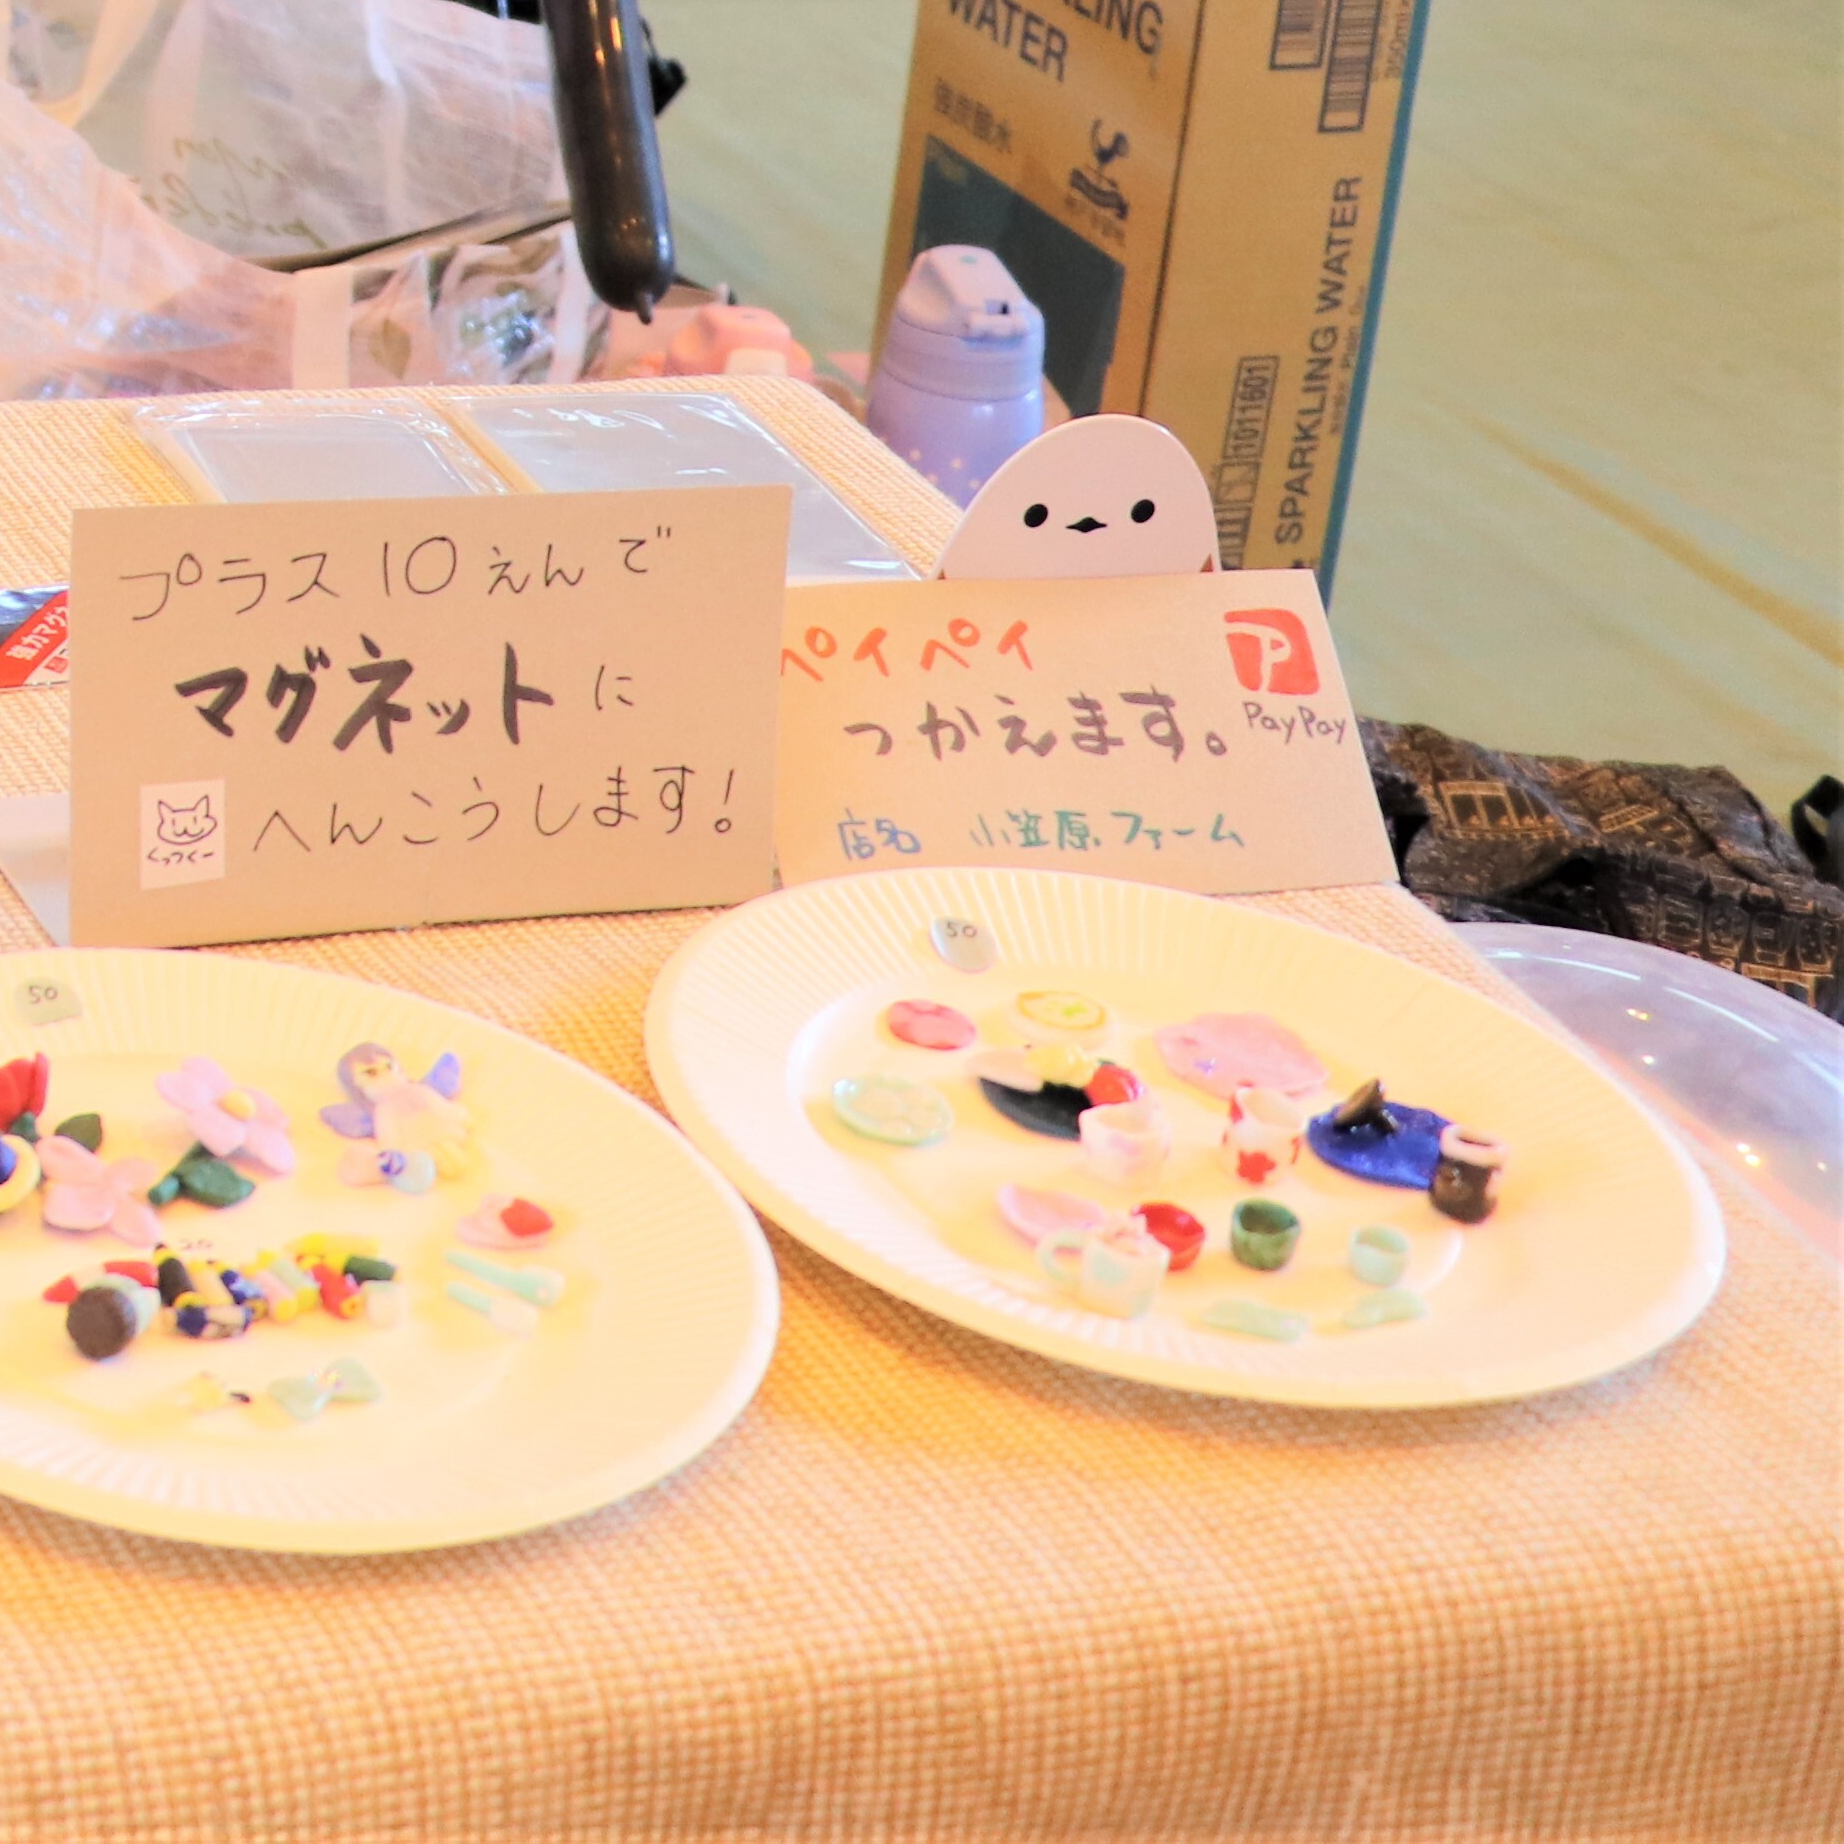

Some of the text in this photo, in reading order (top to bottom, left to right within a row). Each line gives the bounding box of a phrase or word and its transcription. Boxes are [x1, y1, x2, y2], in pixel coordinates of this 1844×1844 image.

[1274, 173, 1364, 546] SPARKLING WATER
[779, 617, 1034, 683] ペイペイ
[843, 685, 1228, 763] つかえます。
[1242, 700, 1348, 746] PayPay
[943, 921, 979, 941] 50
[28, 982, 59, 1004] 50
